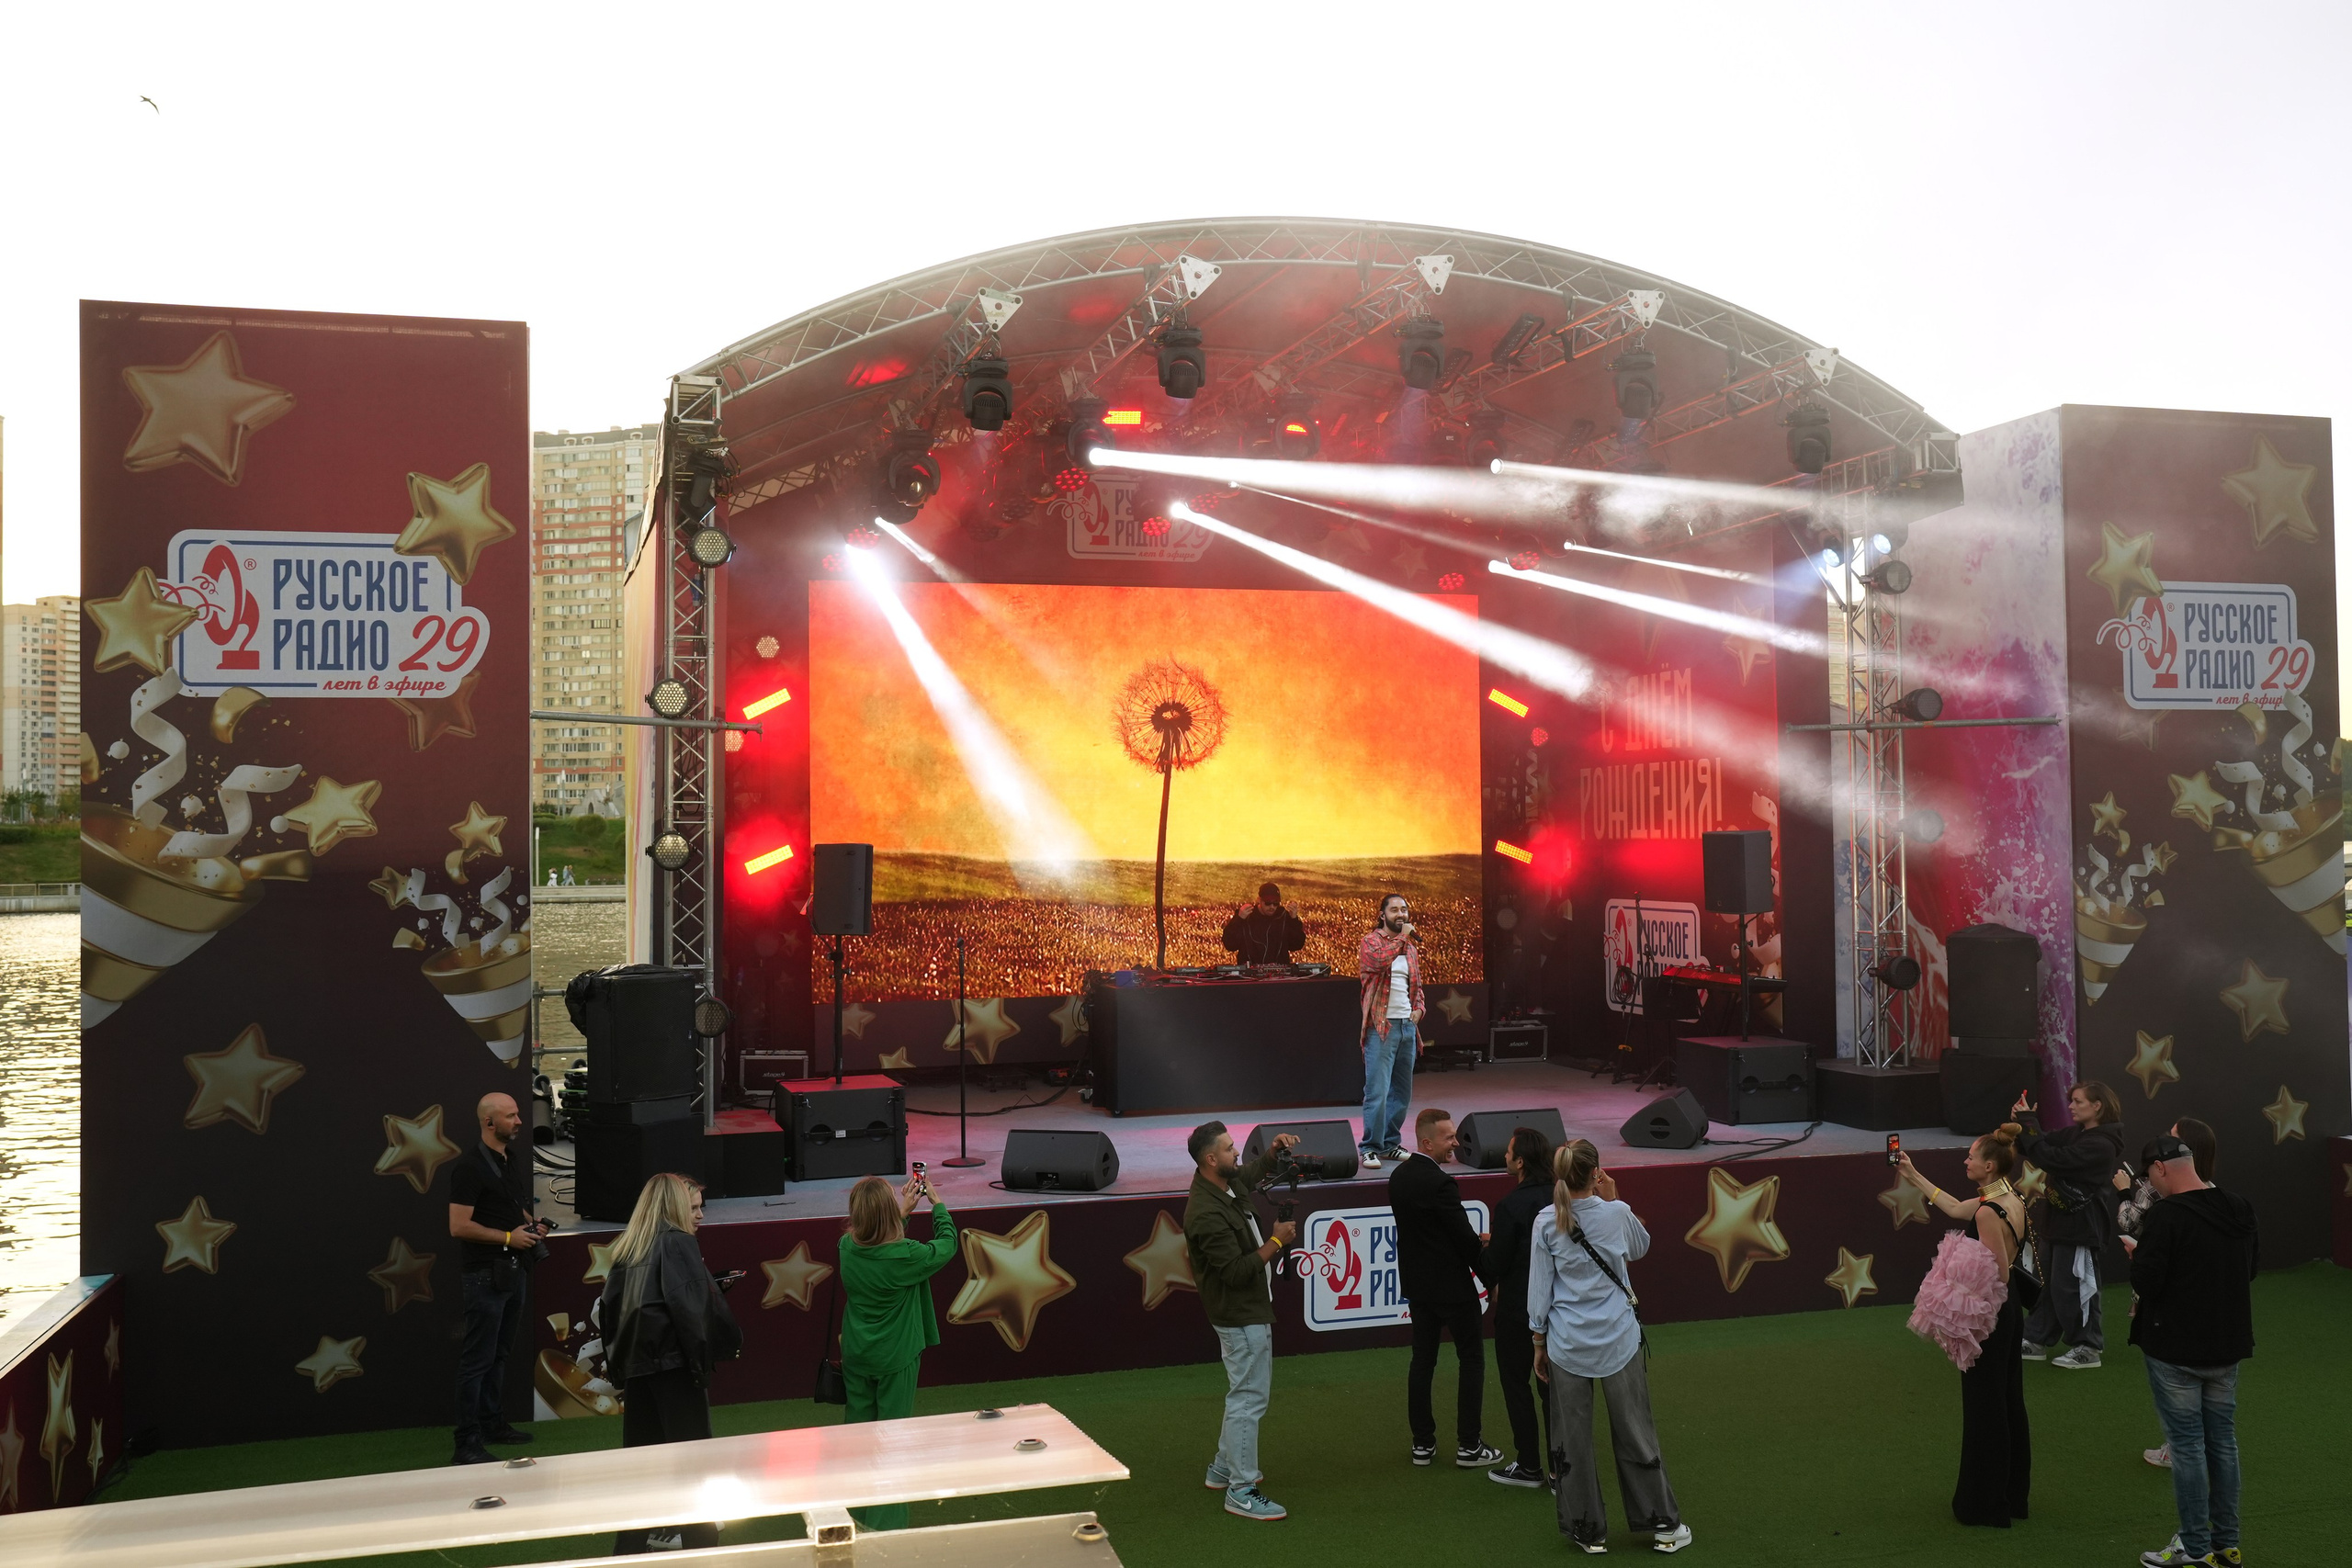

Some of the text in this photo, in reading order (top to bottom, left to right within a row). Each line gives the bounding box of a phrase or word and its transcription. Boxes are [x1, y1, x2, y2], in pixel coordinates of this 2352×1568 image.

[273, 558, 429, 613] РУССКОЕ
[273, 615, 481, 672] РАДИО 29
[2184, 603, 2278, 644] РУССКОЕ
[322, 674, 447, 696] лет в эфире
[2185, 646, 2310, 691] РАДИО 29
[1600, 662, 1693, 753] С ДНЁМ
[2216, 693, 2284, 709] лет в эфир
[1579, 757, 1723, 840] РОЖДЕНИЯ!
